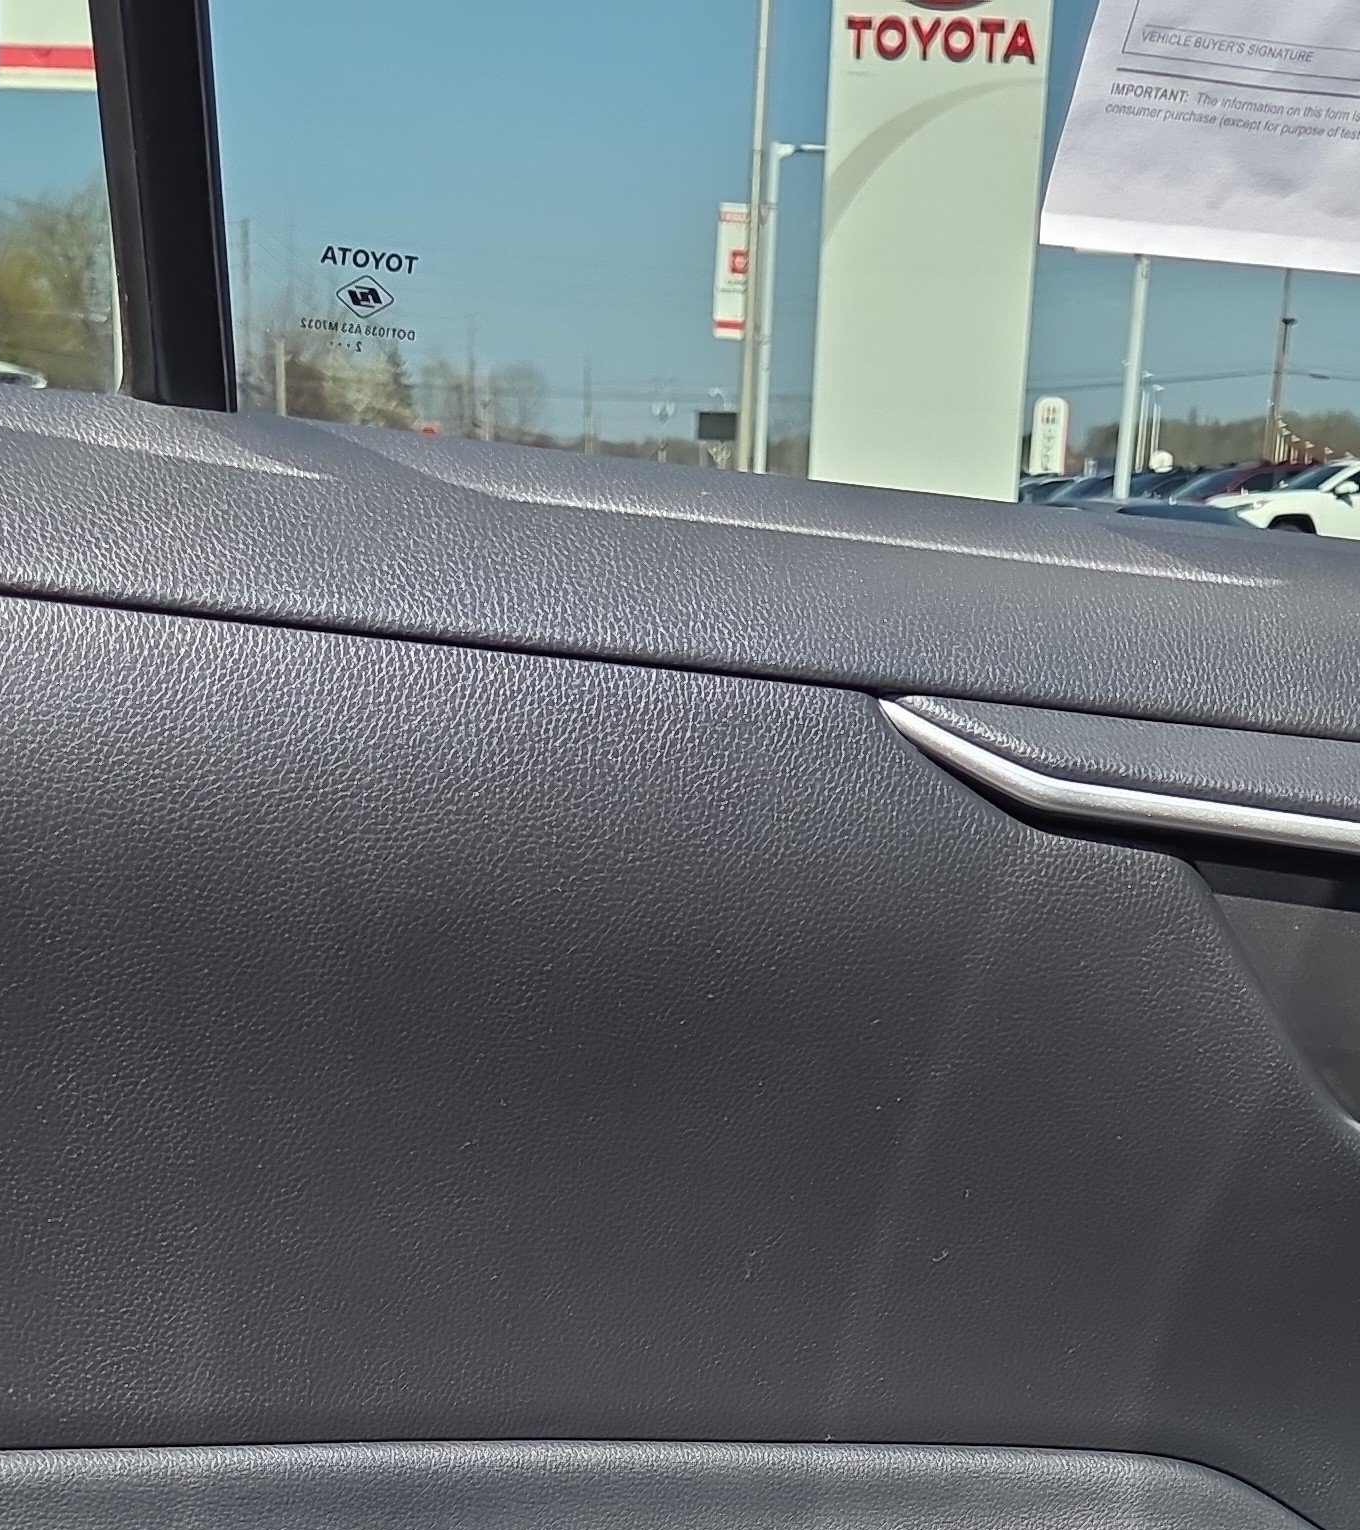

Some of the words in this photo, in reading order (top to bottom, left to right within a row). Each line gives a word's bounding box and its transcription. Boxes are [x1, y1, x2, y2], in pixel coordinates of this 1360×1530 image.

[847, 15, 1036, 65] TOYOTA
[1142, 30, 1195, 47] VEHICLE
[1194, 36, 1244, 53] BUYER'S
[1247, 43, 1314, 63] SIGNATURE
[1104, 103, 1162, 119] consumer
[1163, 109, 1217, 125] purchase
[1219, 114, 1262, 131] (except
[1263, 119, 1278, 133] for
[1280, 122, 1326, 137] purpose
[1327, 125, 1340, 138] of
[1110, 82, 1190, 103] IMPORTANT:
[1196, 91, 1220, 107] The
[1220, 95, 1285, 115] information
[1286, 106, 1301, 116] on
[1303, 104, 1324, 119] this
[1324, 107, 1350, 121] form
[1352, 109, 1360, 123] is
